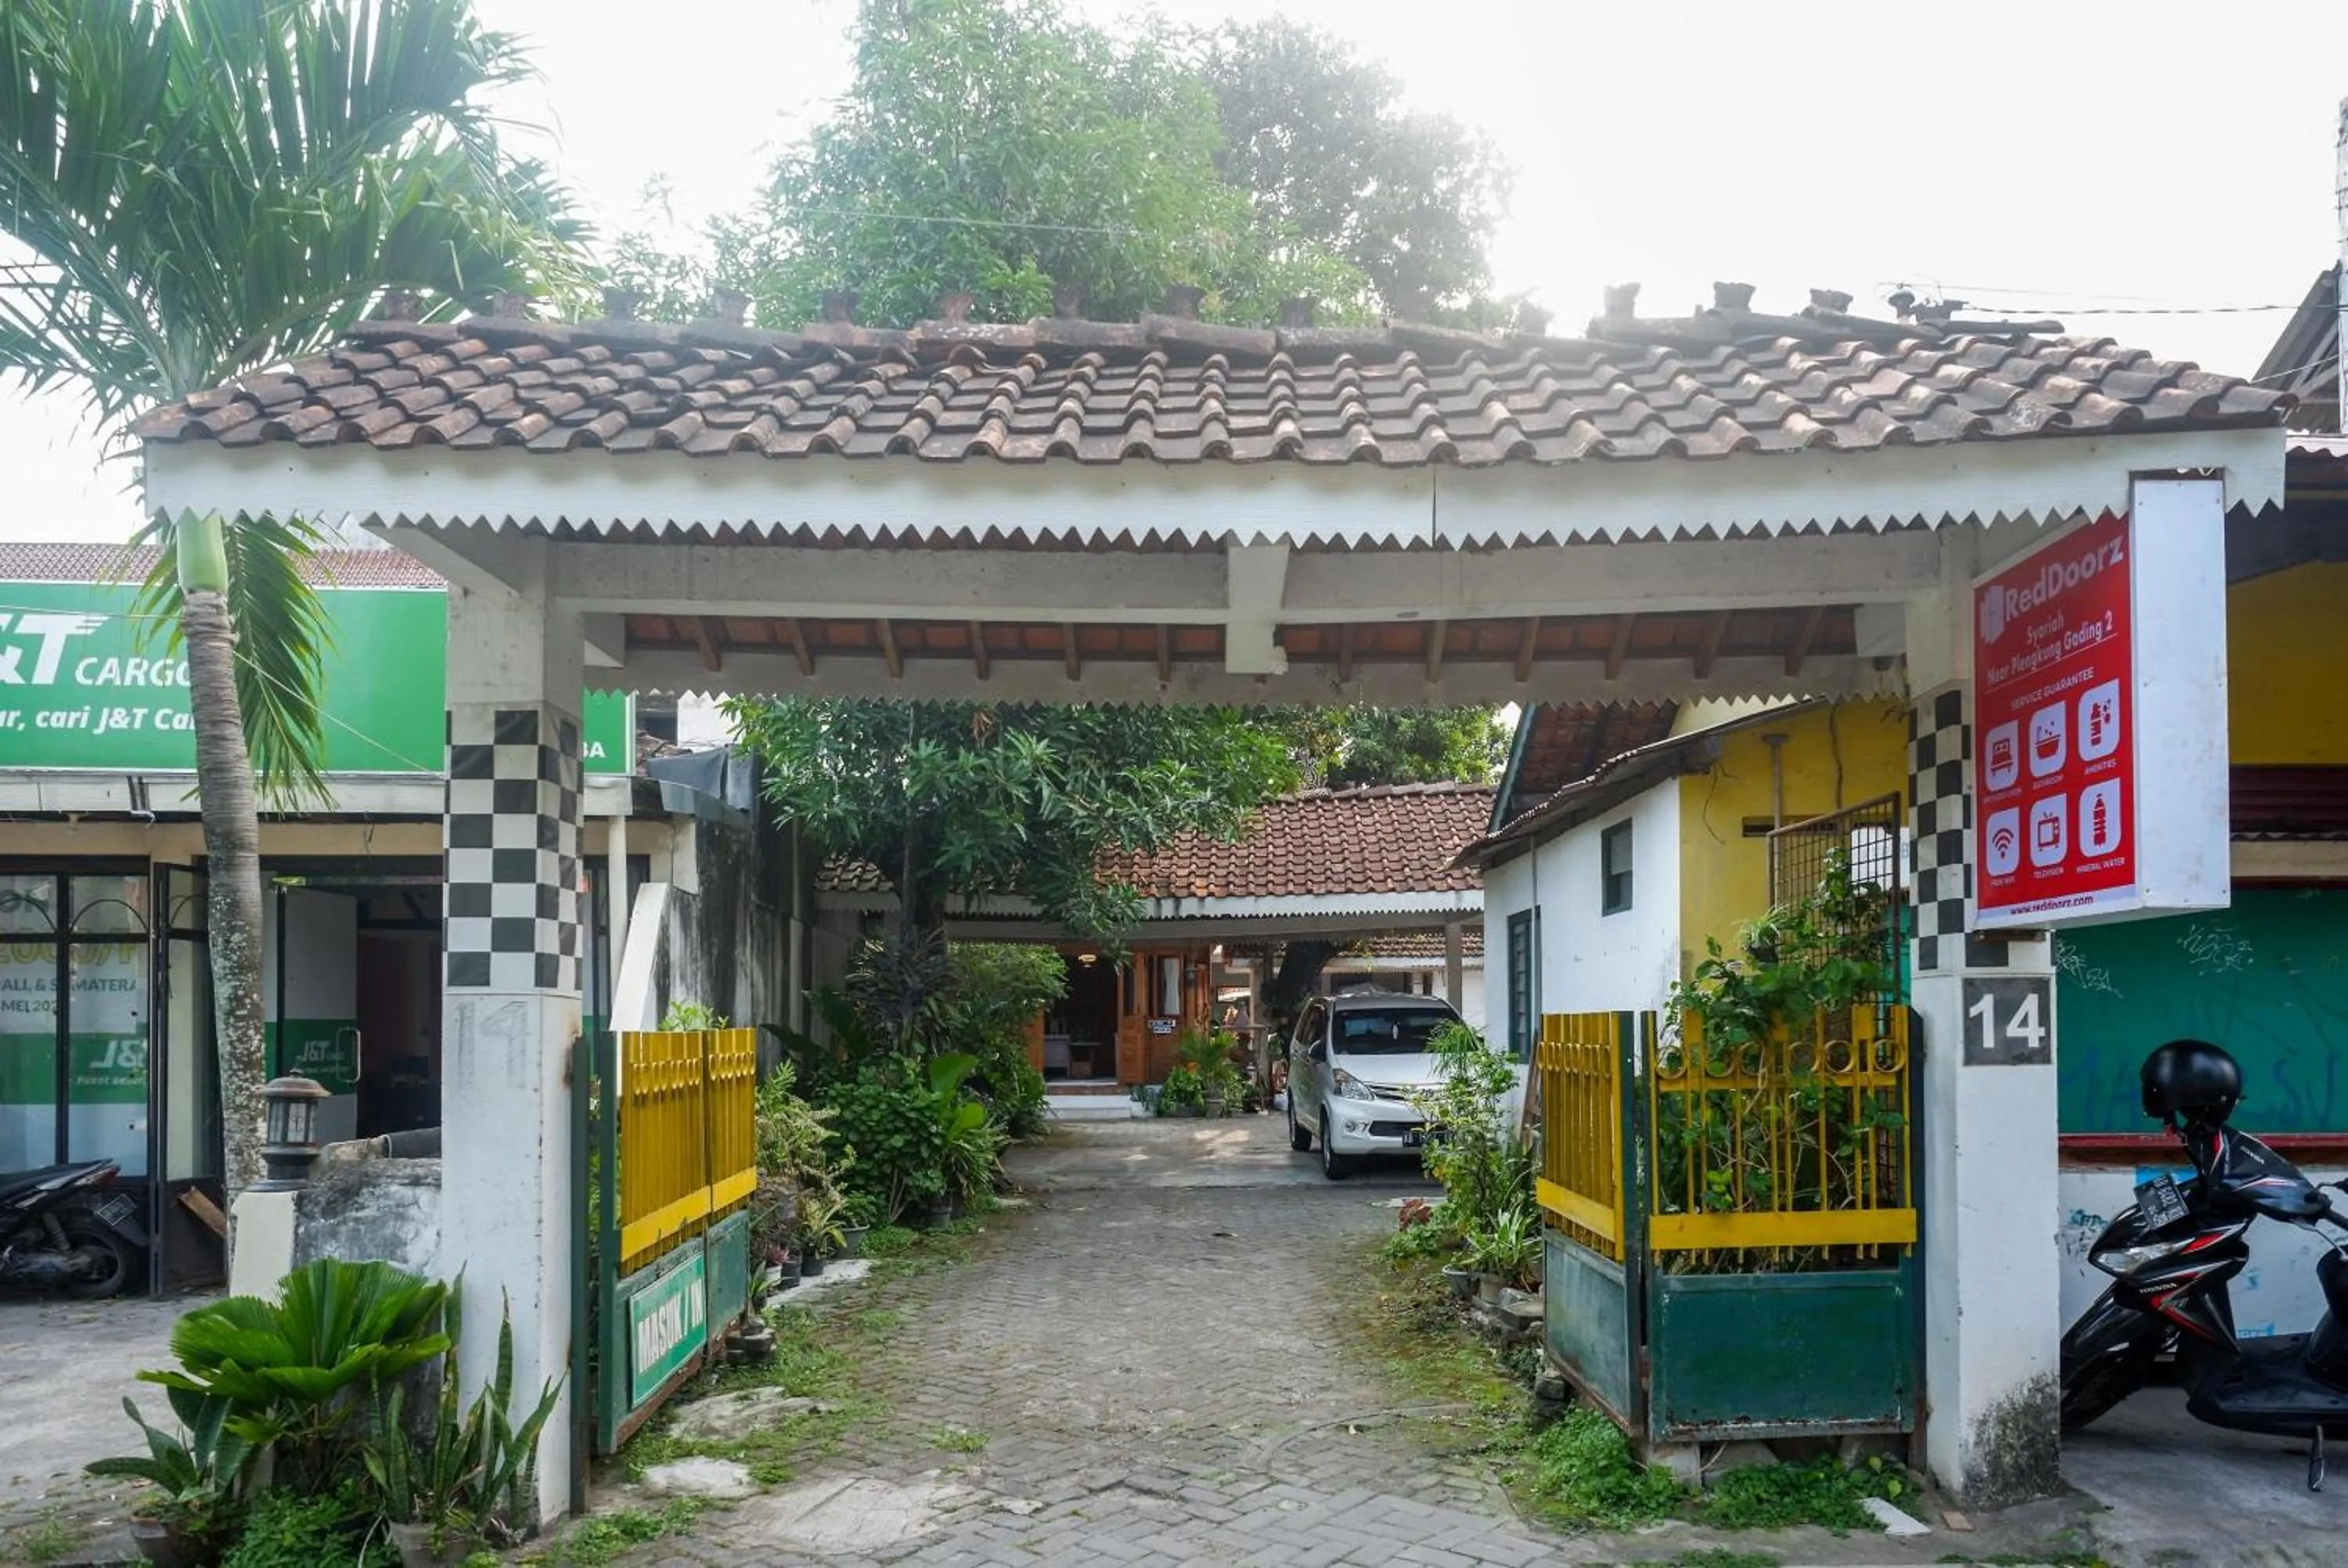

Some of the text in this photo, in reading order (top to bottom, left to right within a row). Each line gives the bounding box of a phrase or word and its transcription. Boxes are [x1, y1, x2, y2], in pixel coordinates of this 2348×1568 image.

[2005, 535, 2123, 621] RedDoorz
[2026, 609, 2065, 646] Syariah
[2063, 620, 2103, 650] Gading
[2104, 610, 2113, 632] 2
[2011, 666, 2095, 712] SERVICE GUARANTEE
[35, 705, 91, 729] cari
[92, 707, 149, 734] J&T
[2010, 895, 2094, 915] www.reddoorz.com
[1969, 994, 2045, 1048] 14
